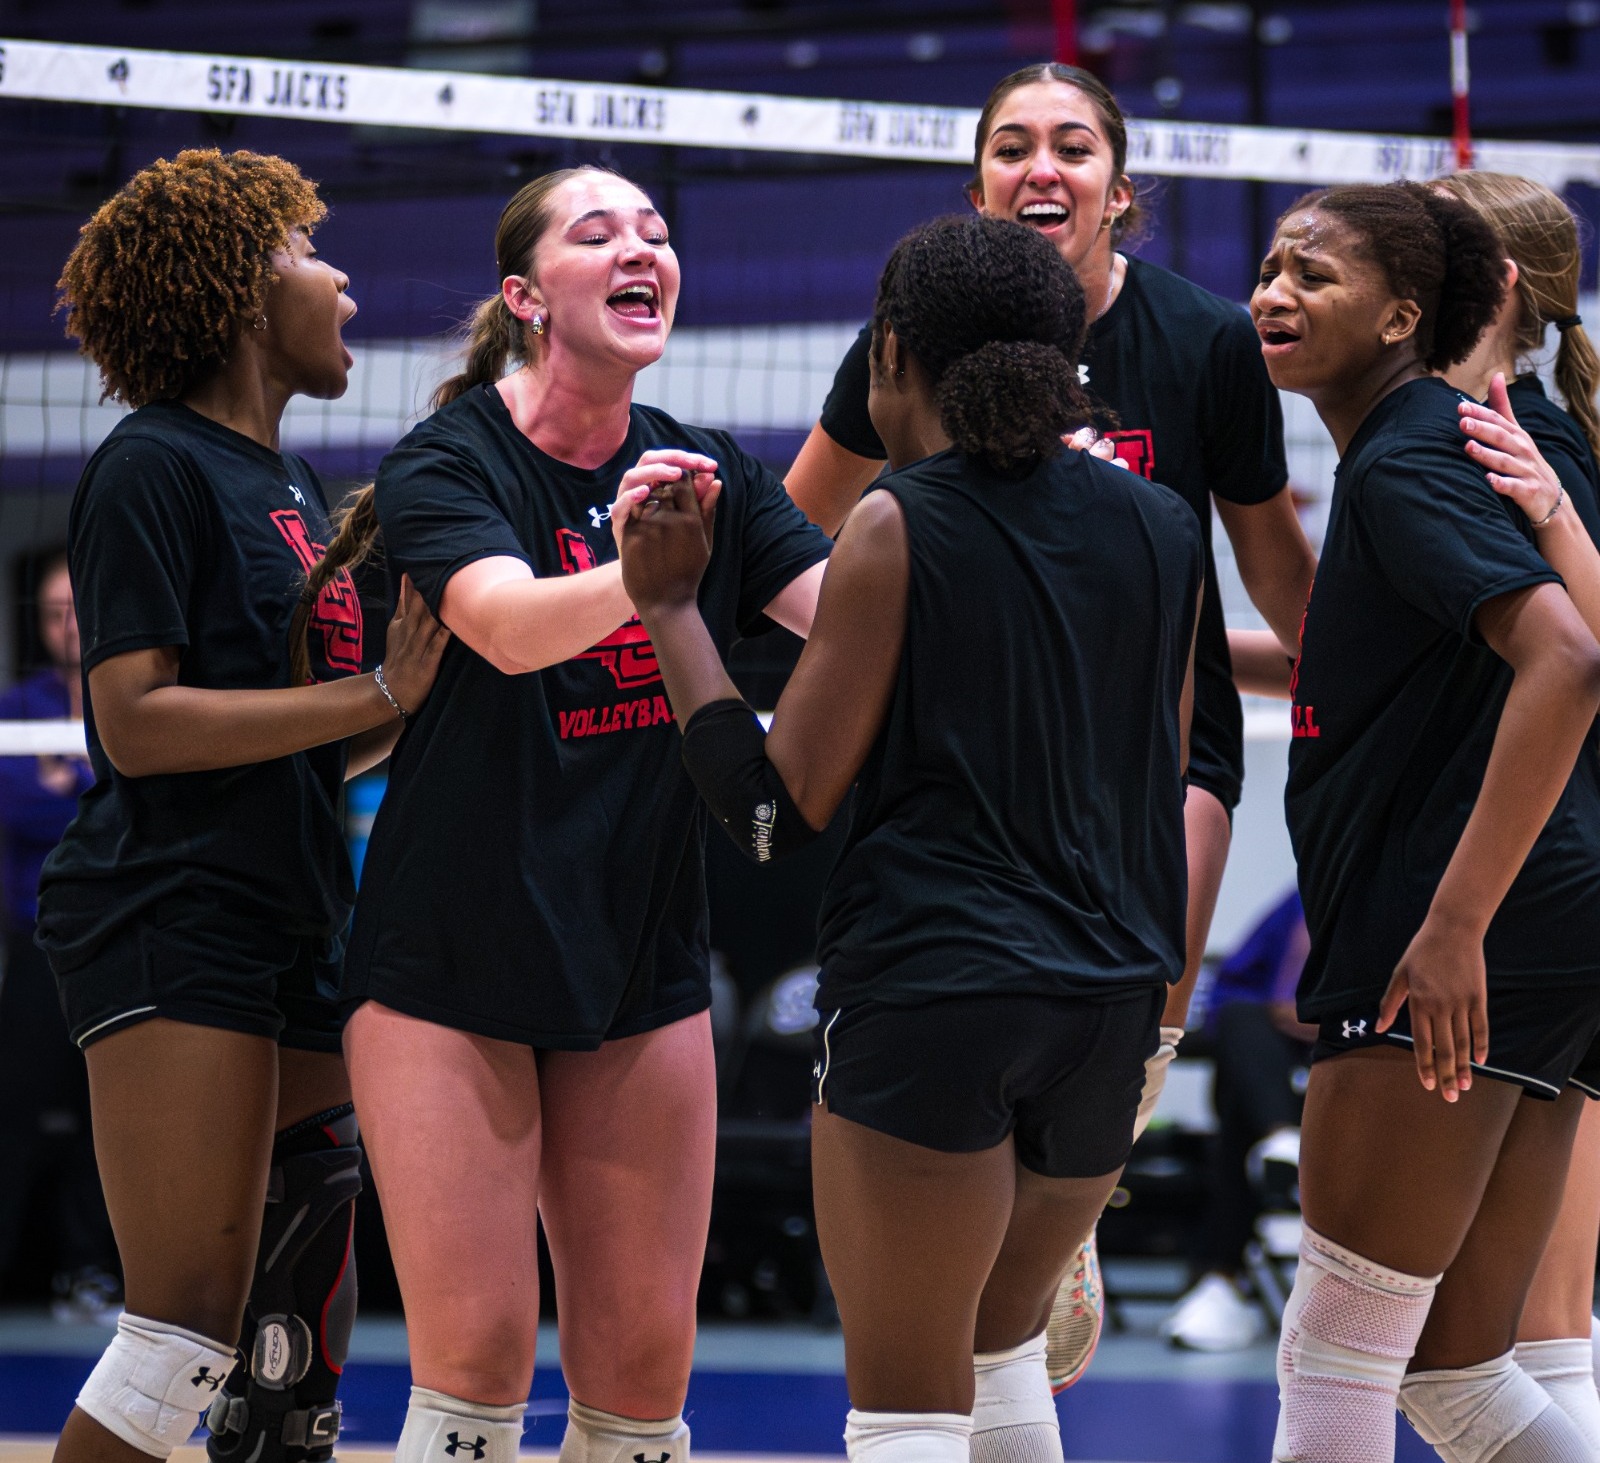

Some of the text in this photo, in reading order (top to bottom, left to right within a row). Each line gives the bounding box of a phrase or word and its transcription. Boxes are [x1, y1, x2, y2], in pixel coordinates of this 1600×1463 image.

[207, 64, 348, 111] SFA JACKS
[558, 694, 679, 740] VOLLEYBA
